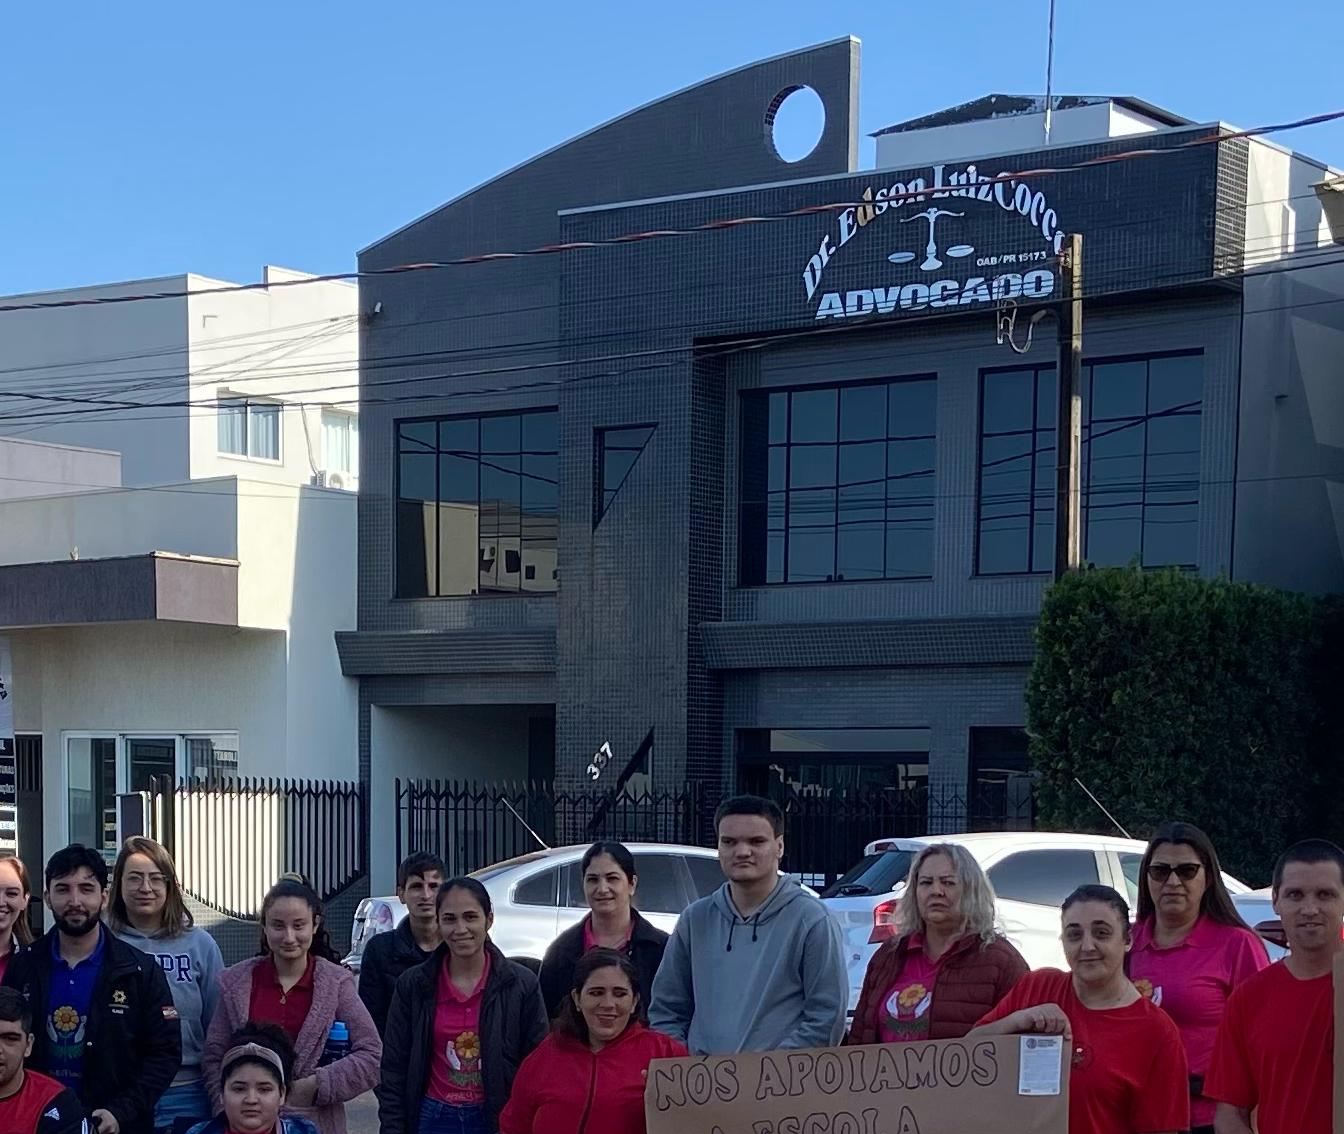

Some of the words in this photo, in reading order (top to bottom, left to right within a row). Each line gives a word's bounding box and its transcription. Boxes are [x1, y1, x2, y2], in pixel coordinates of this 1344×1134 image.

[803, 234, 836, 303] Dr.
[838, 178, 926, 247] Edson
[932, 165, 992, 202] Luiz
[976, 255, 1016, 267] OAB/PR
[1018, 250, 1047, 262] 15173
[815, 269, 1055, 321] ADVOGADO
[156, 952, 193, 983] PR
[655, 1053, 740, 1111] NÓS
[755, 1041, 999, 1100] APOIAMOS
